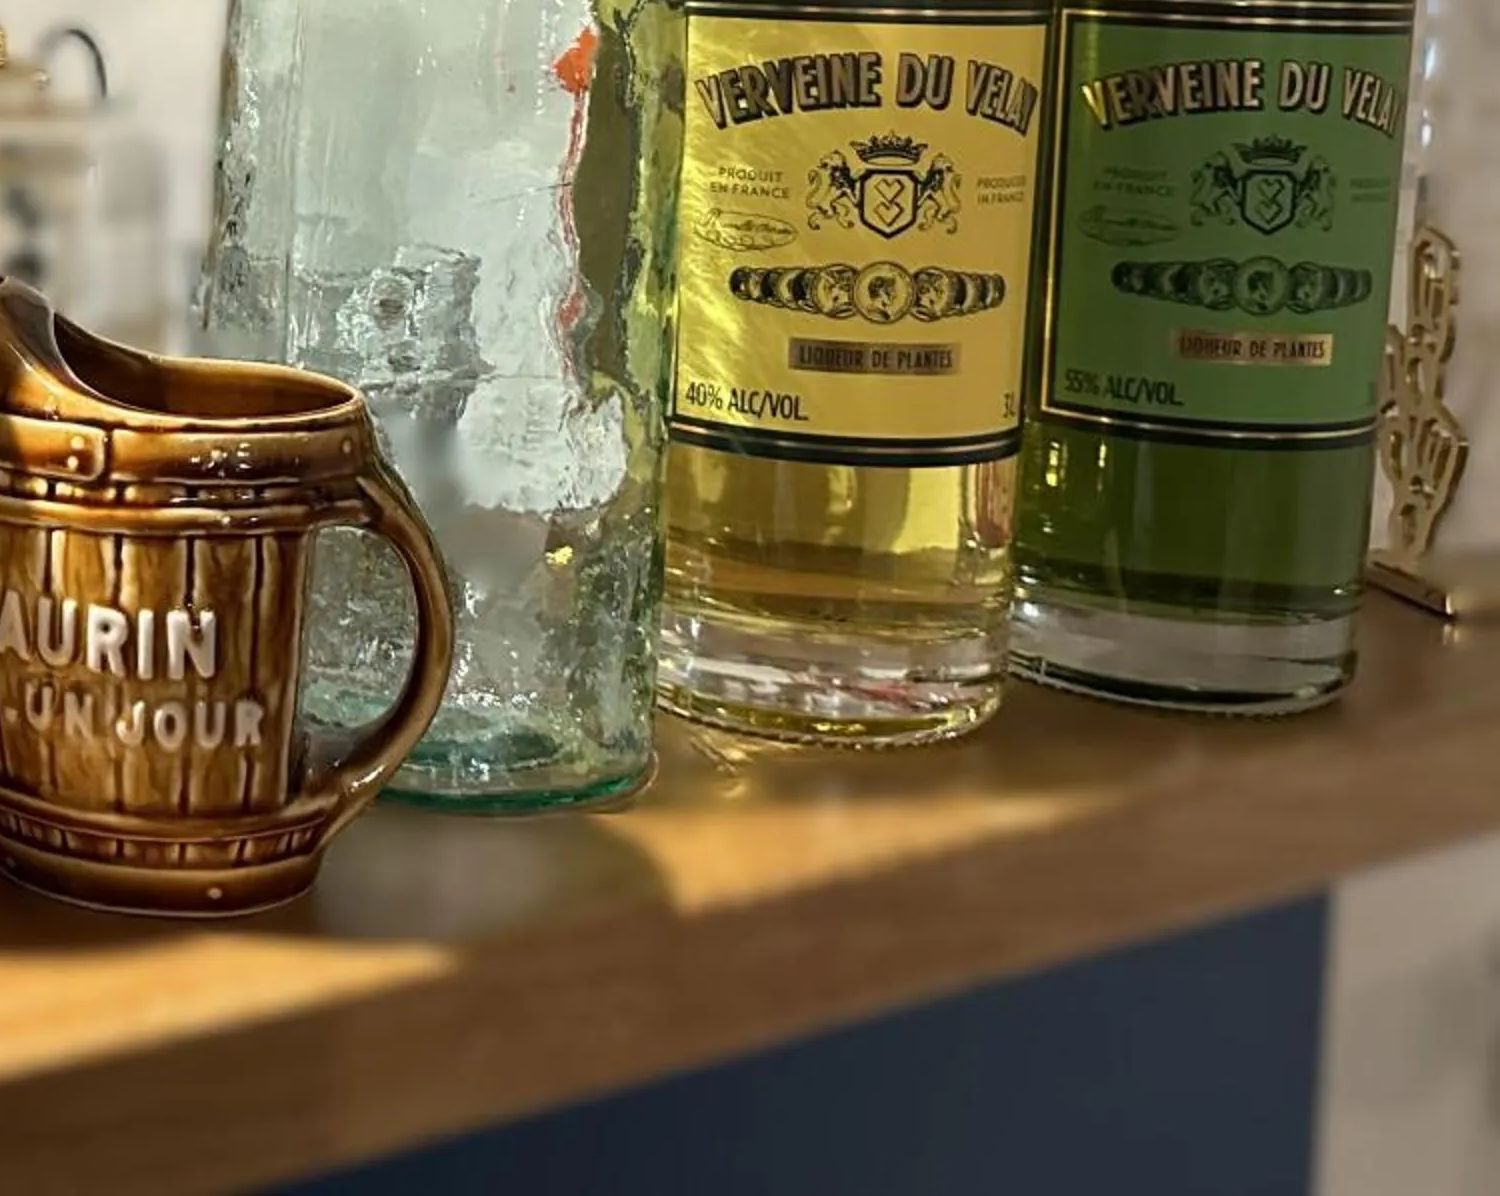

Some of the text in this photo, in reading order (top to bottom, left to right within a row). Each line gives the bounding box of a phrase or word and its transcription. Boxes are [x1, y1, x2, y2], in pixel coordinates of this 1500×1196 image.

[694, 52, 882, 130] VERVEINE
[896, 53, 954, 110] DU
[1080, 59, 1266, 132] VERVEINE
[1277, 59, 1332, 113] DU
[718, 165, 784, 183] PRODUIT
[731, 183, 790, 200] FRANCE
[799, 345, 954, 369] LIQUEUR DE PLANTES
[1250, 340, 1268, 357] DE
[1273, 339, 1326, 359] PLANTES
[685, 381, 723, 410] 40%
[24, 684, 265, 753] UN JOUR
